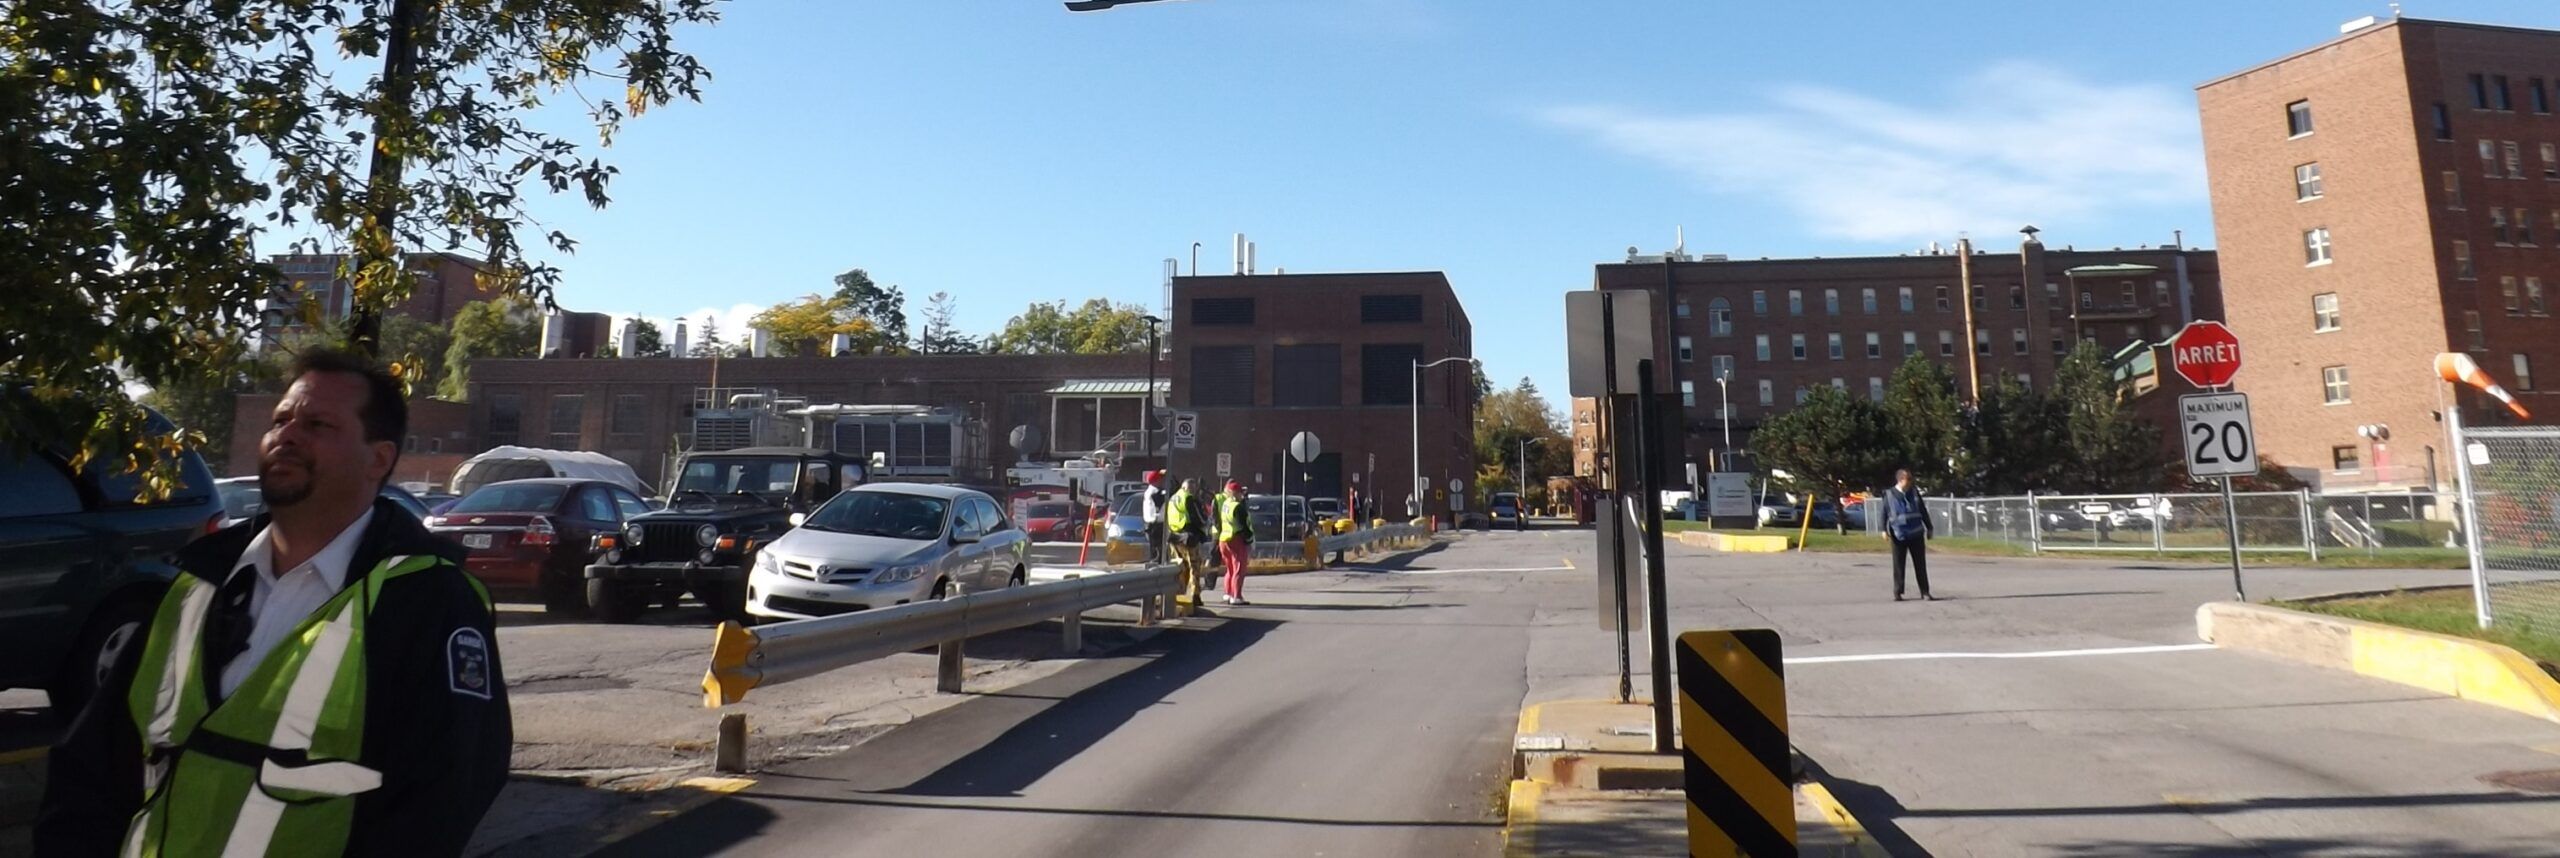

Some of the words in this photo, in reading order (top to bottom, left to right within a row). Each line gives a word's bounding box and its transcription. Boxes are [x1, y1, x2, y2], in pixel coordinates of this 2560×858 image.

[2179, 341, 2237, 365] ARRÊT
[2186, 401, 2243, 414] MAXIMUM
[2191, 420, 2248, 464] 20
